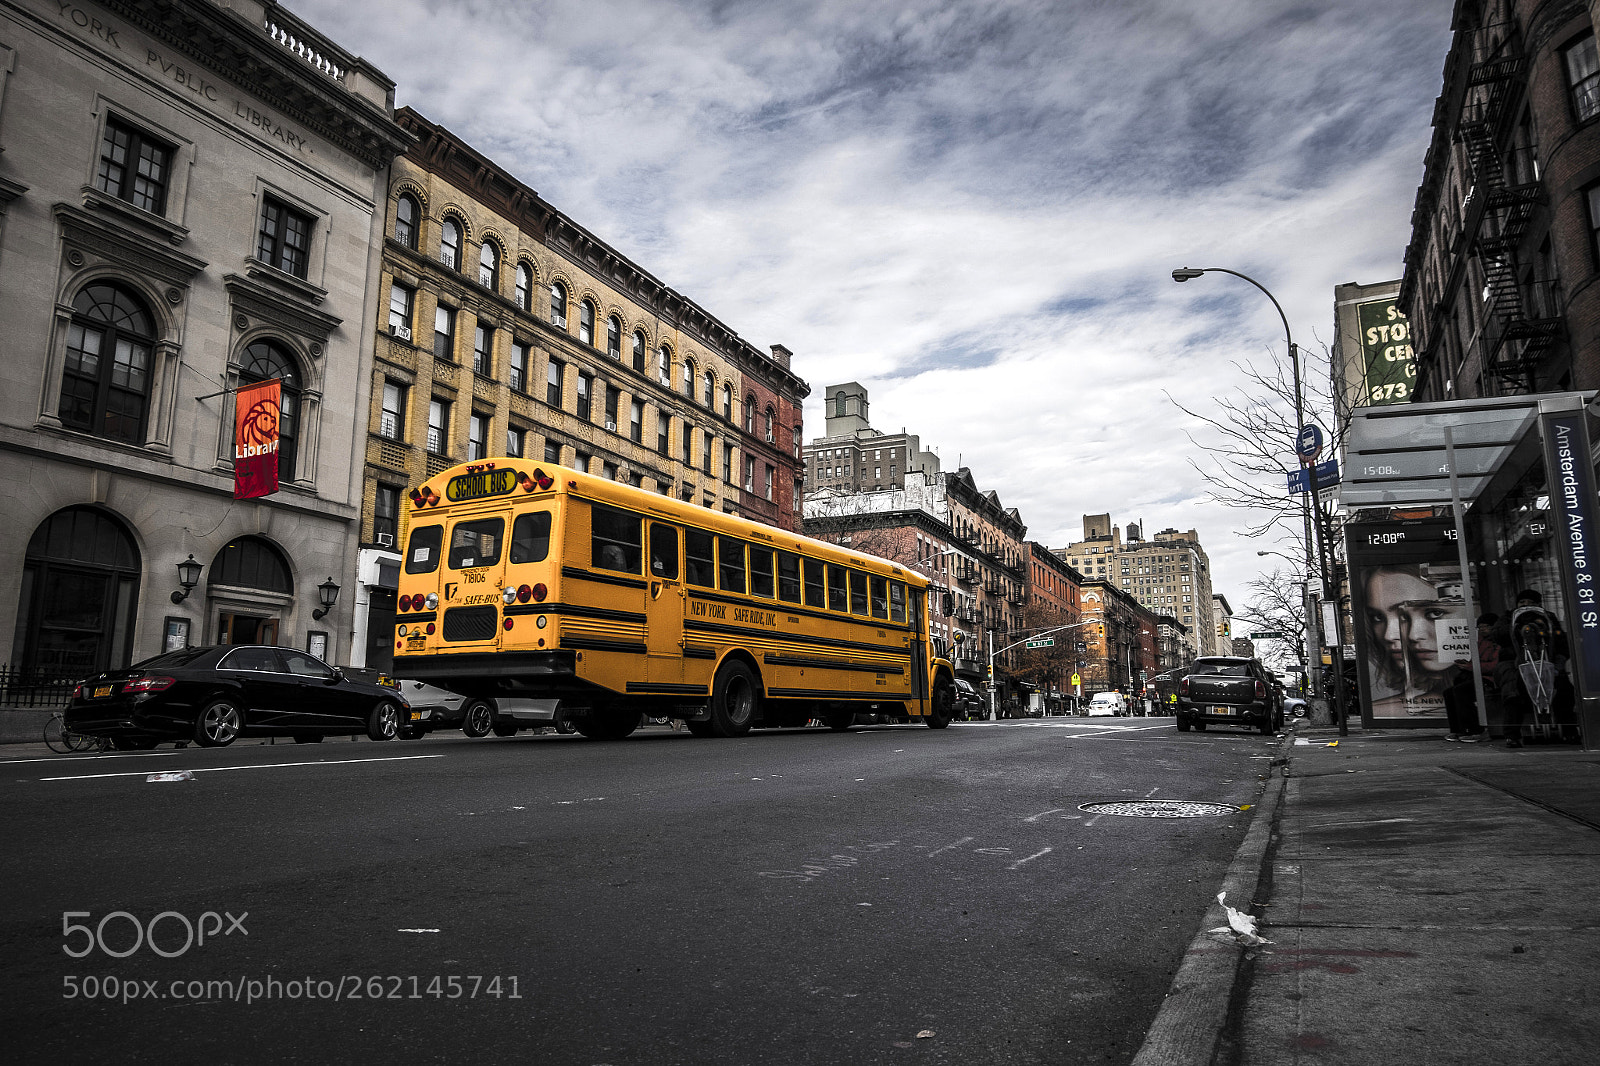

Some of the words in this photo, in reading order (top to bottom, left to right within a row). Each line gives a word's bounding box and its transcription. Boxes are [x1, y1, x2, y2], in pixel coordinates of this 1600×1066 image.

[57, 1, 121, 49] YORK
[145, 50, 218, 102] PVBLIC
[231, 101, 307, 151] LIBRARY
[1555, 425, 1579, 509] Amsterdam
[455, 474, 488, 498] SCHOOL
[490, 471, 508, 494] BUS
[1289, 483, 1303, 493] M11
[1568, 513, 1587, 569] Avenue
[1576, 573, 1592, 585] &
[463, 594, 501, 605] SAFE-BUS
[1579, 588, 1595, 604] 81
[690, 600, 708, 618] NEW
[708, 604, 727, 620] YORK
[734, 608, 750, 624] SAFE
[1581, 611, 1598, 628] St
